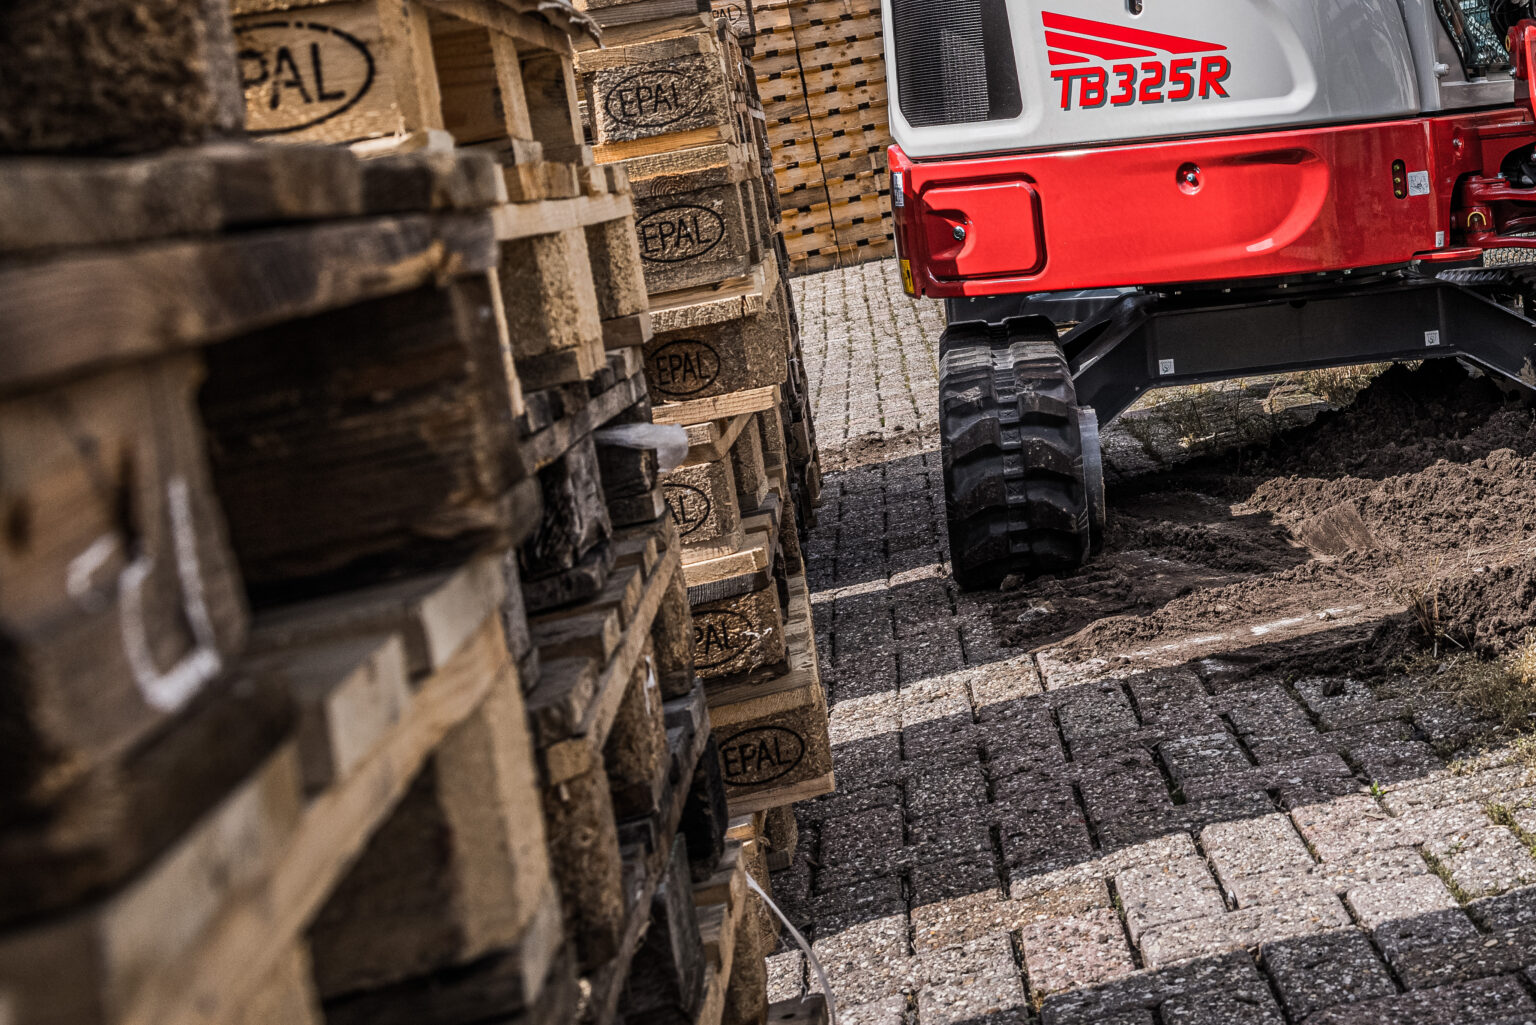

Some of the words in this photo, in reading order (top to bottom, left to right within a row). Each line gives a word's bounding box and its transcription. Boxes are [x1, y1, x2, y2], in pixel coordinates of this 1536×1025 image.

[618, 81, 686, 118] EPAL
[1050, 55, 1232, 112] TB325R
[641, 215, 713, 254] EPAL
[655, 351, 712, 386] EPAL
[721, 736, 793, 777] EPAL
